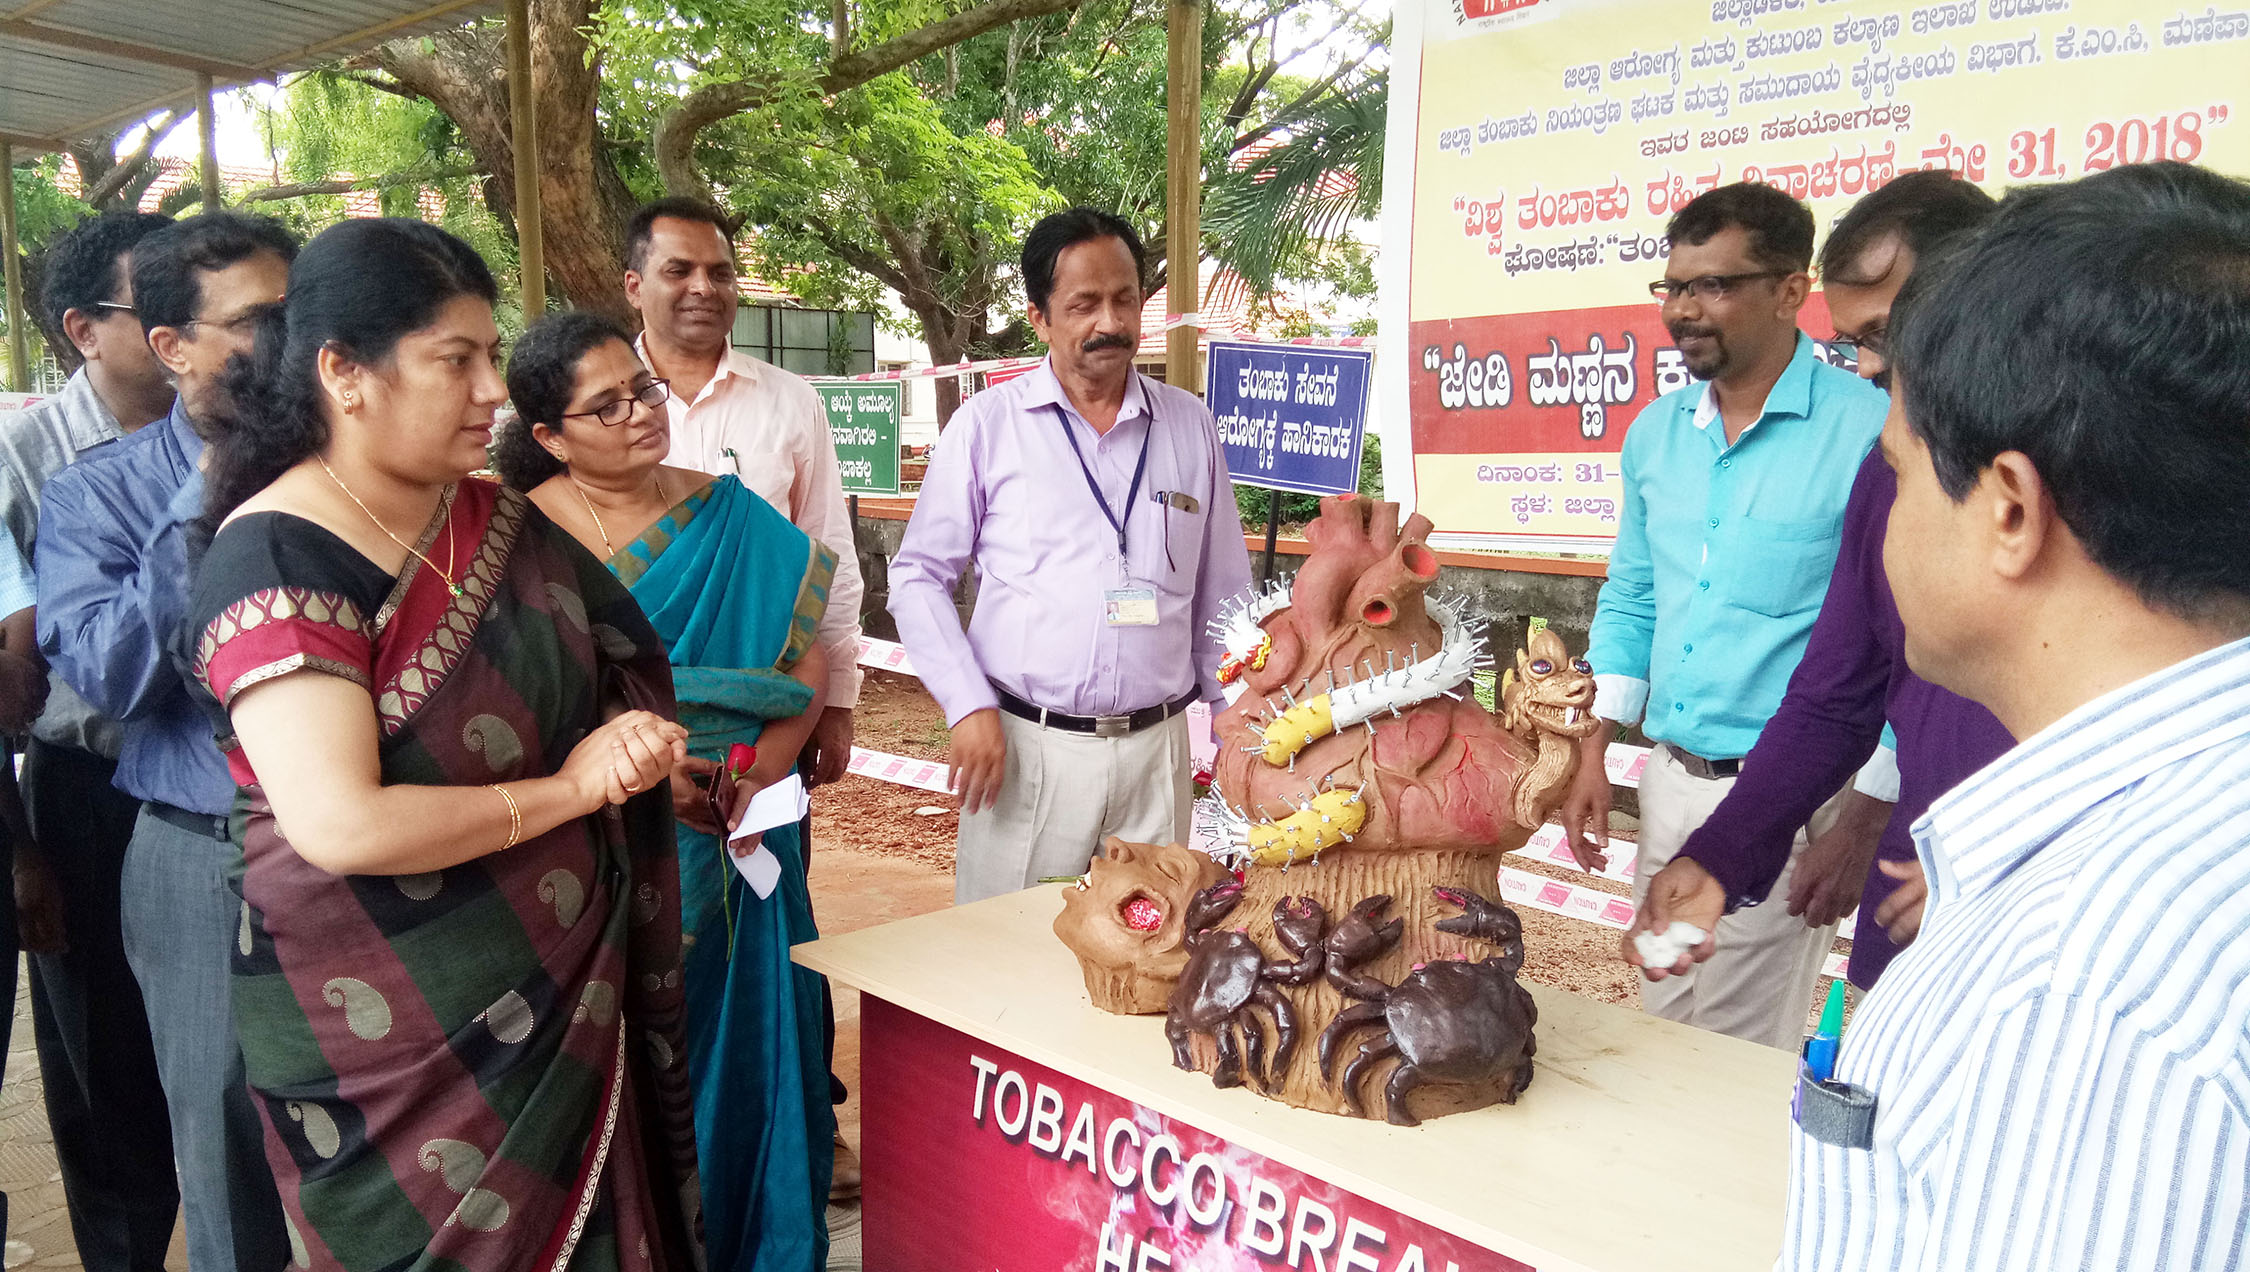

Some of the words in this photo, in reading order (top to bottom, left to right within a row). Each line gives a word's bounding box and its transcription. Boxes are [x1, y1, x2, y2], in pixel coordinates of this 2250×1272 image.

[1563, 64, 1601, 93] ಜಿಲ್ಲಾ
[1609, 45, 1682, 85] ಆರೋಗ್ಯ
[1690, 35, 1745, 72] ಮತ್ತು
[1746, 27, 1822, 59] ಕುಟುಂಬ
[1833, 15, 1900, 54] ಕಲ್ಯಾಣ
[1439, 127, 1471, 156] ಜಿಲ್ಲಾ
[1478, 110, 1538, 144] ತಂಬಾಕು
[1546, 97, 1622, 134] ನಿಯಂತ್ರಣ
[1631, 87, 1675, 123] ಘಟಕ
[1684, 80, 1729, 117] ಮತ್ತು
[1739, 63, 1840, 104] ಸಮುದಾಯ
[1851, 45, 1955, 100] ವೈದ್ಯಕೀಯ
[1967, 33, 2041, 72] ವಿಭಾಗ.
[1640, 129, 1689, 157] ಇವರ
[1700, 125, 1749, 149] ಜಂಟಿ
[1760, 101, 1911, 142] ಸಹಯೋಗದಲ್ಲಿ
[1518, 174, 1629, 230] ತಂಬಾಕು
[2008, 127, 2066, 180] 31,
[1237, 358, 1289, 402] ತಂಬಾಕು
[1294, 362, 1339, 407] ಸೇವನೆ
[1217, 405, 1277, 470] ಆರೋಗ್ಯಕ್ಕೆ
[1281, 416, 1353, 459] ಹಾನಿಕಾರಕ
[1477, 463, 1562, 482] ದಿನಾಂಕ:
[1565, 498, 1616, 522] ಜಿಲ್ಲಾ
[969, 1055, 1226, 1226] TOBACCO
